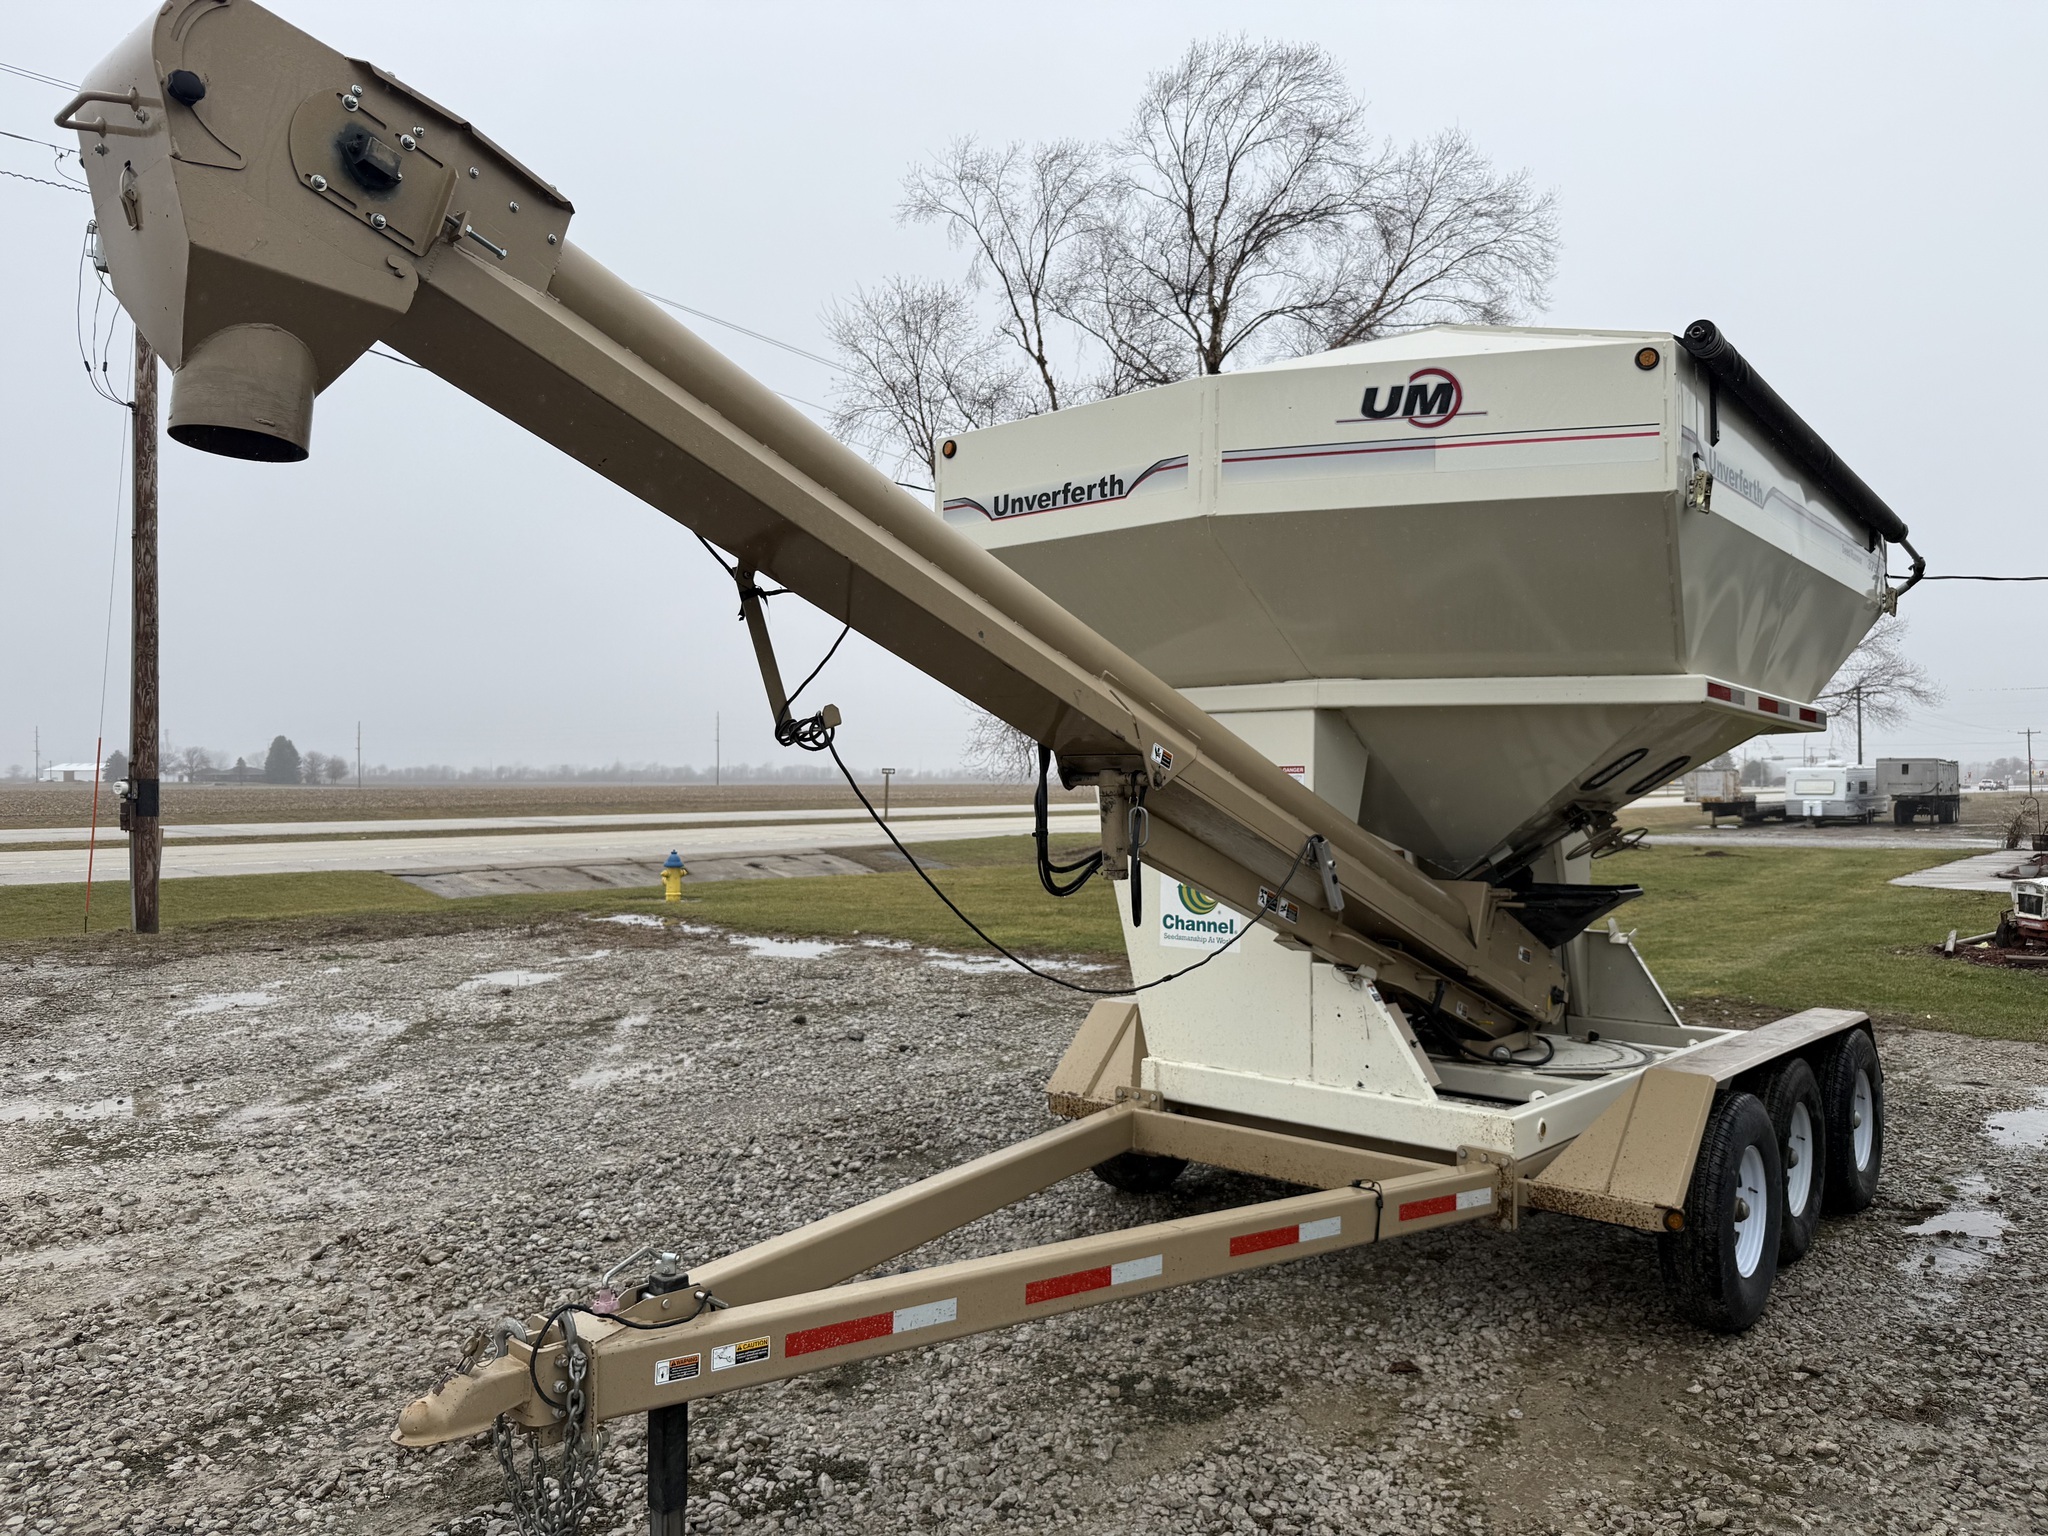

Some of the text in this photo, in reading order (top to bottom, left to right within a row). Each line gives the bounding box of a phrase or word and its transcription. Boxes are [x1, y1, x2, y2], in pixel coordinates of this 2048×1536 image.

[1361, 382, 1454, 419] UM
[1708, 447, 1764, 505] Unverferth
[993, 473, 1124, 517] Unverferth
[1162, 914, 1234, 935] Channel
[1163, 932, 1207, 944] Seedsmanship
[1208, 936, 1215, 944] At
[743, 1339, 768, 1350] CAUTION
[675, 1356, 698, 1366] WARNING
